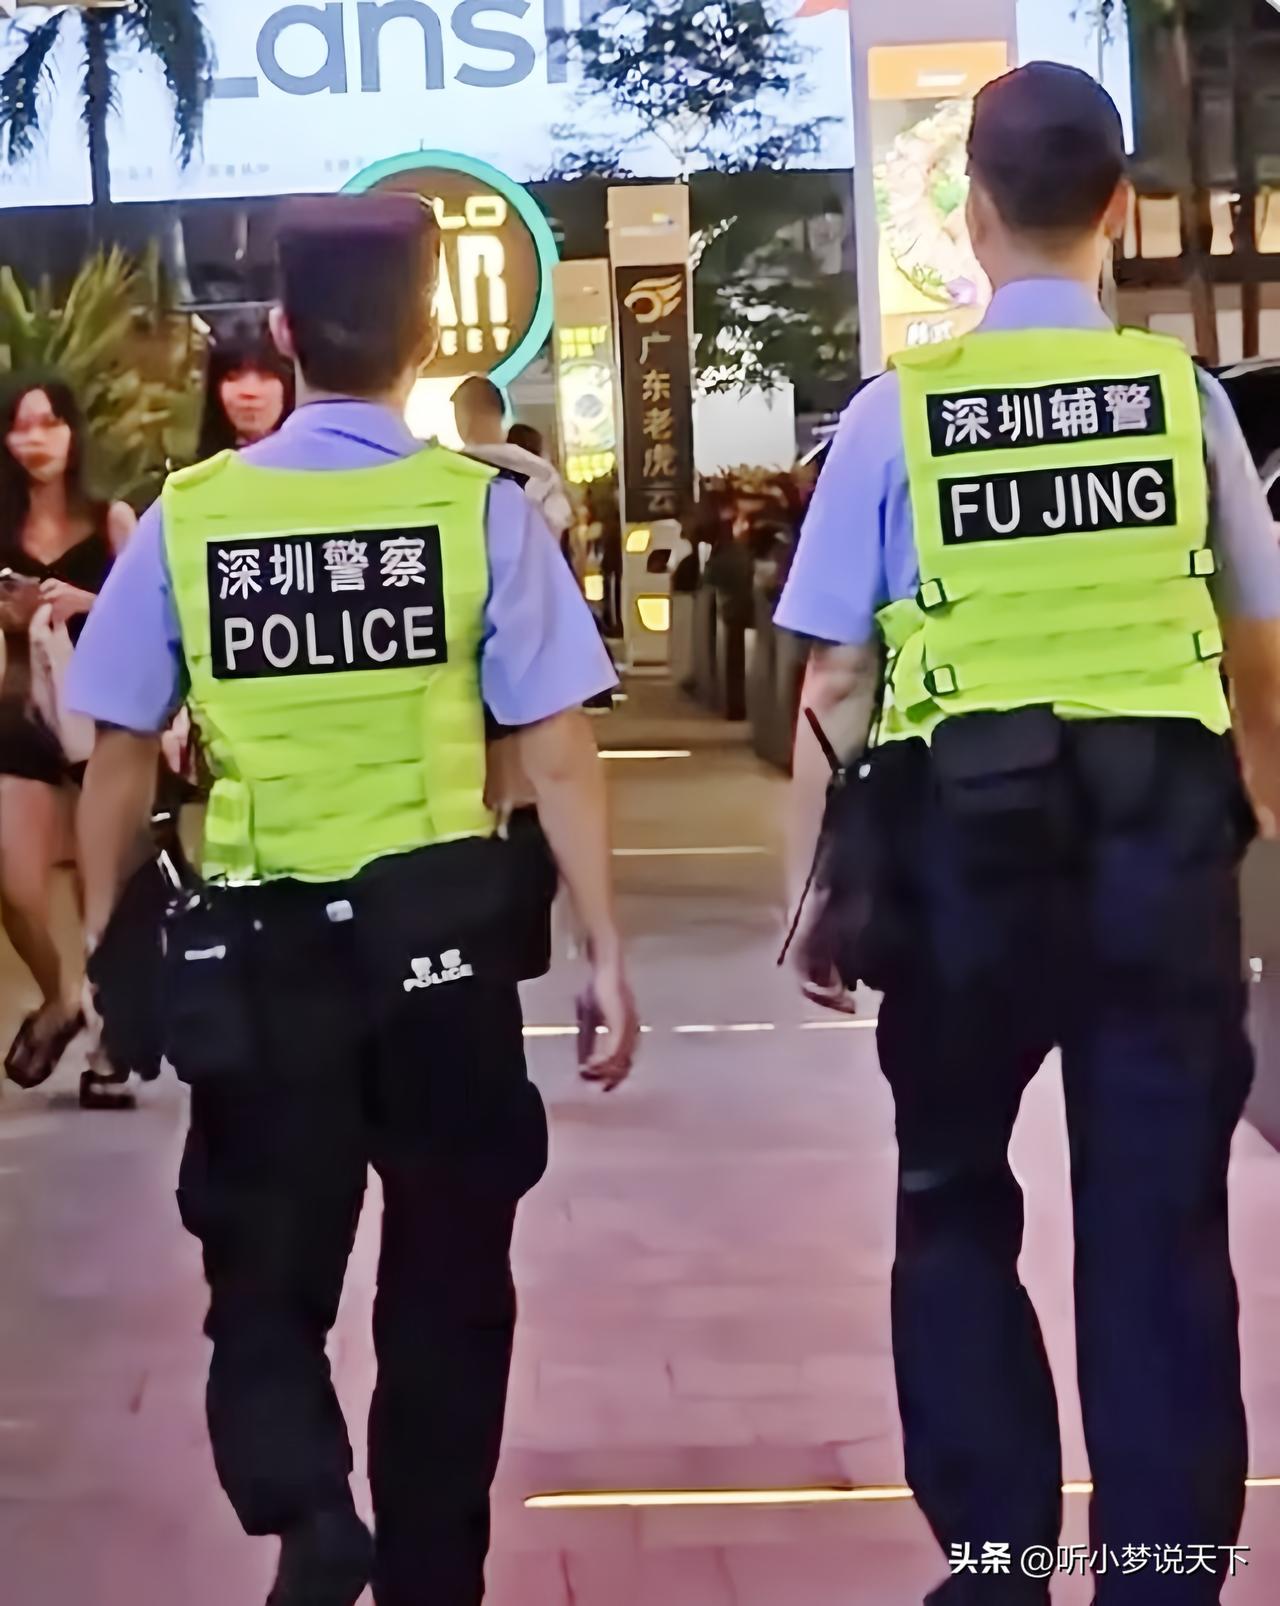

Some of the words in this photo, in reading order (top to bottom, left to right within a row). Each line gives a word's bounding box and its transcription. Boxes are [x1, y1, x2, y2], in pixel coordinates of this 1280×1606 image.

[433, 195, 507, 230] LO
[430, 234, 508, 328] AR
[942, 383, 1152, 446] 深圳辅警
[951, 479, 1021, 537] FU
[1042, 467, 1166, 529] JING
[217, 536, 427, 600] 深圳警察
[224, 606, 437, 671] POLICE
